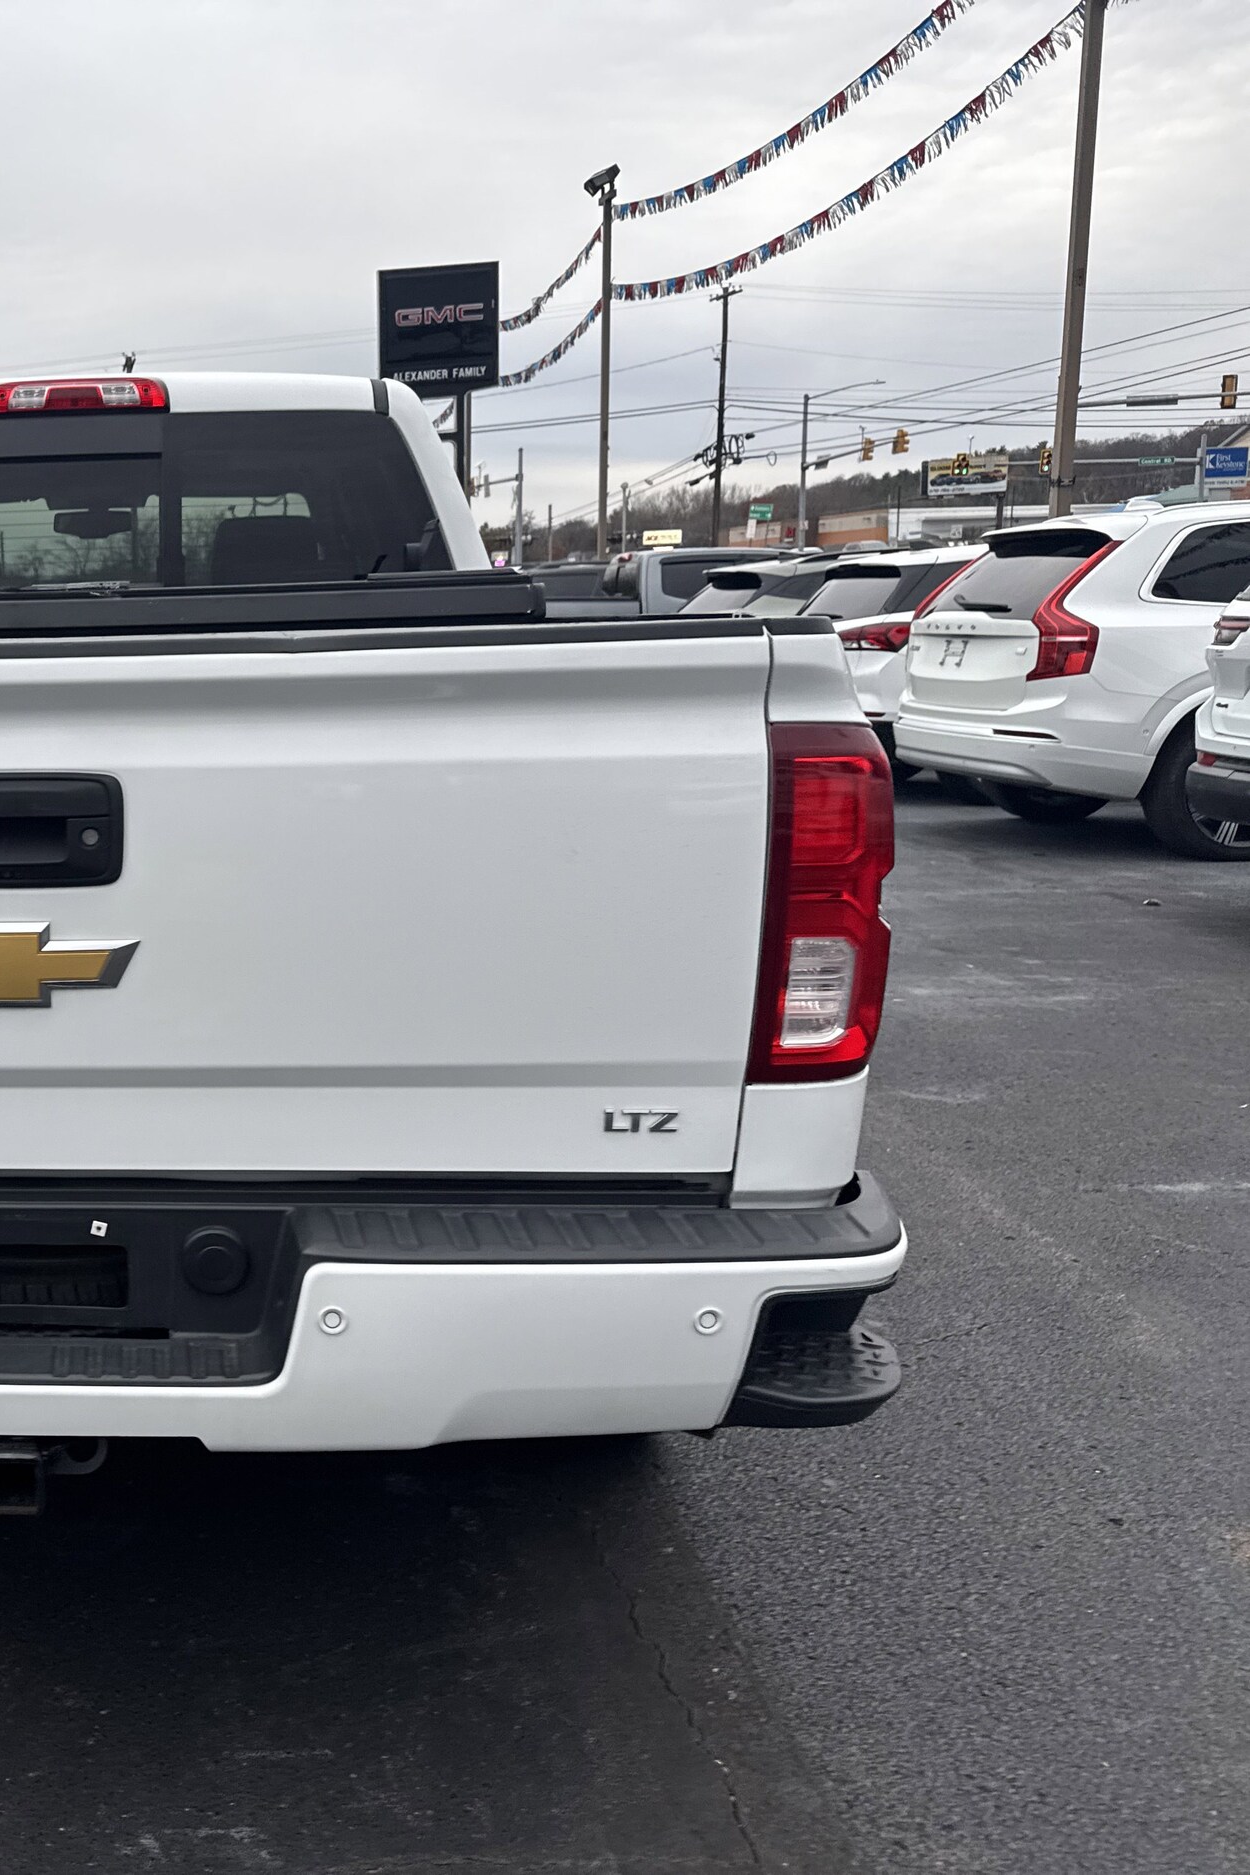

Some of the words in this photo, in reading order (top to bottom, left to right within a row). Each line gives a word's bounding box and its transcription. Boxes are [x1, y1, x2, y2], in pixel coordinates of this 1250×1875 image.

[395, 303, 484, 327] GMC
[393, 369, 449, 382] ALEXANDER
[452, 366, 487, 379] FAMILY
[603, 1108, 679, 1133] LTZ
